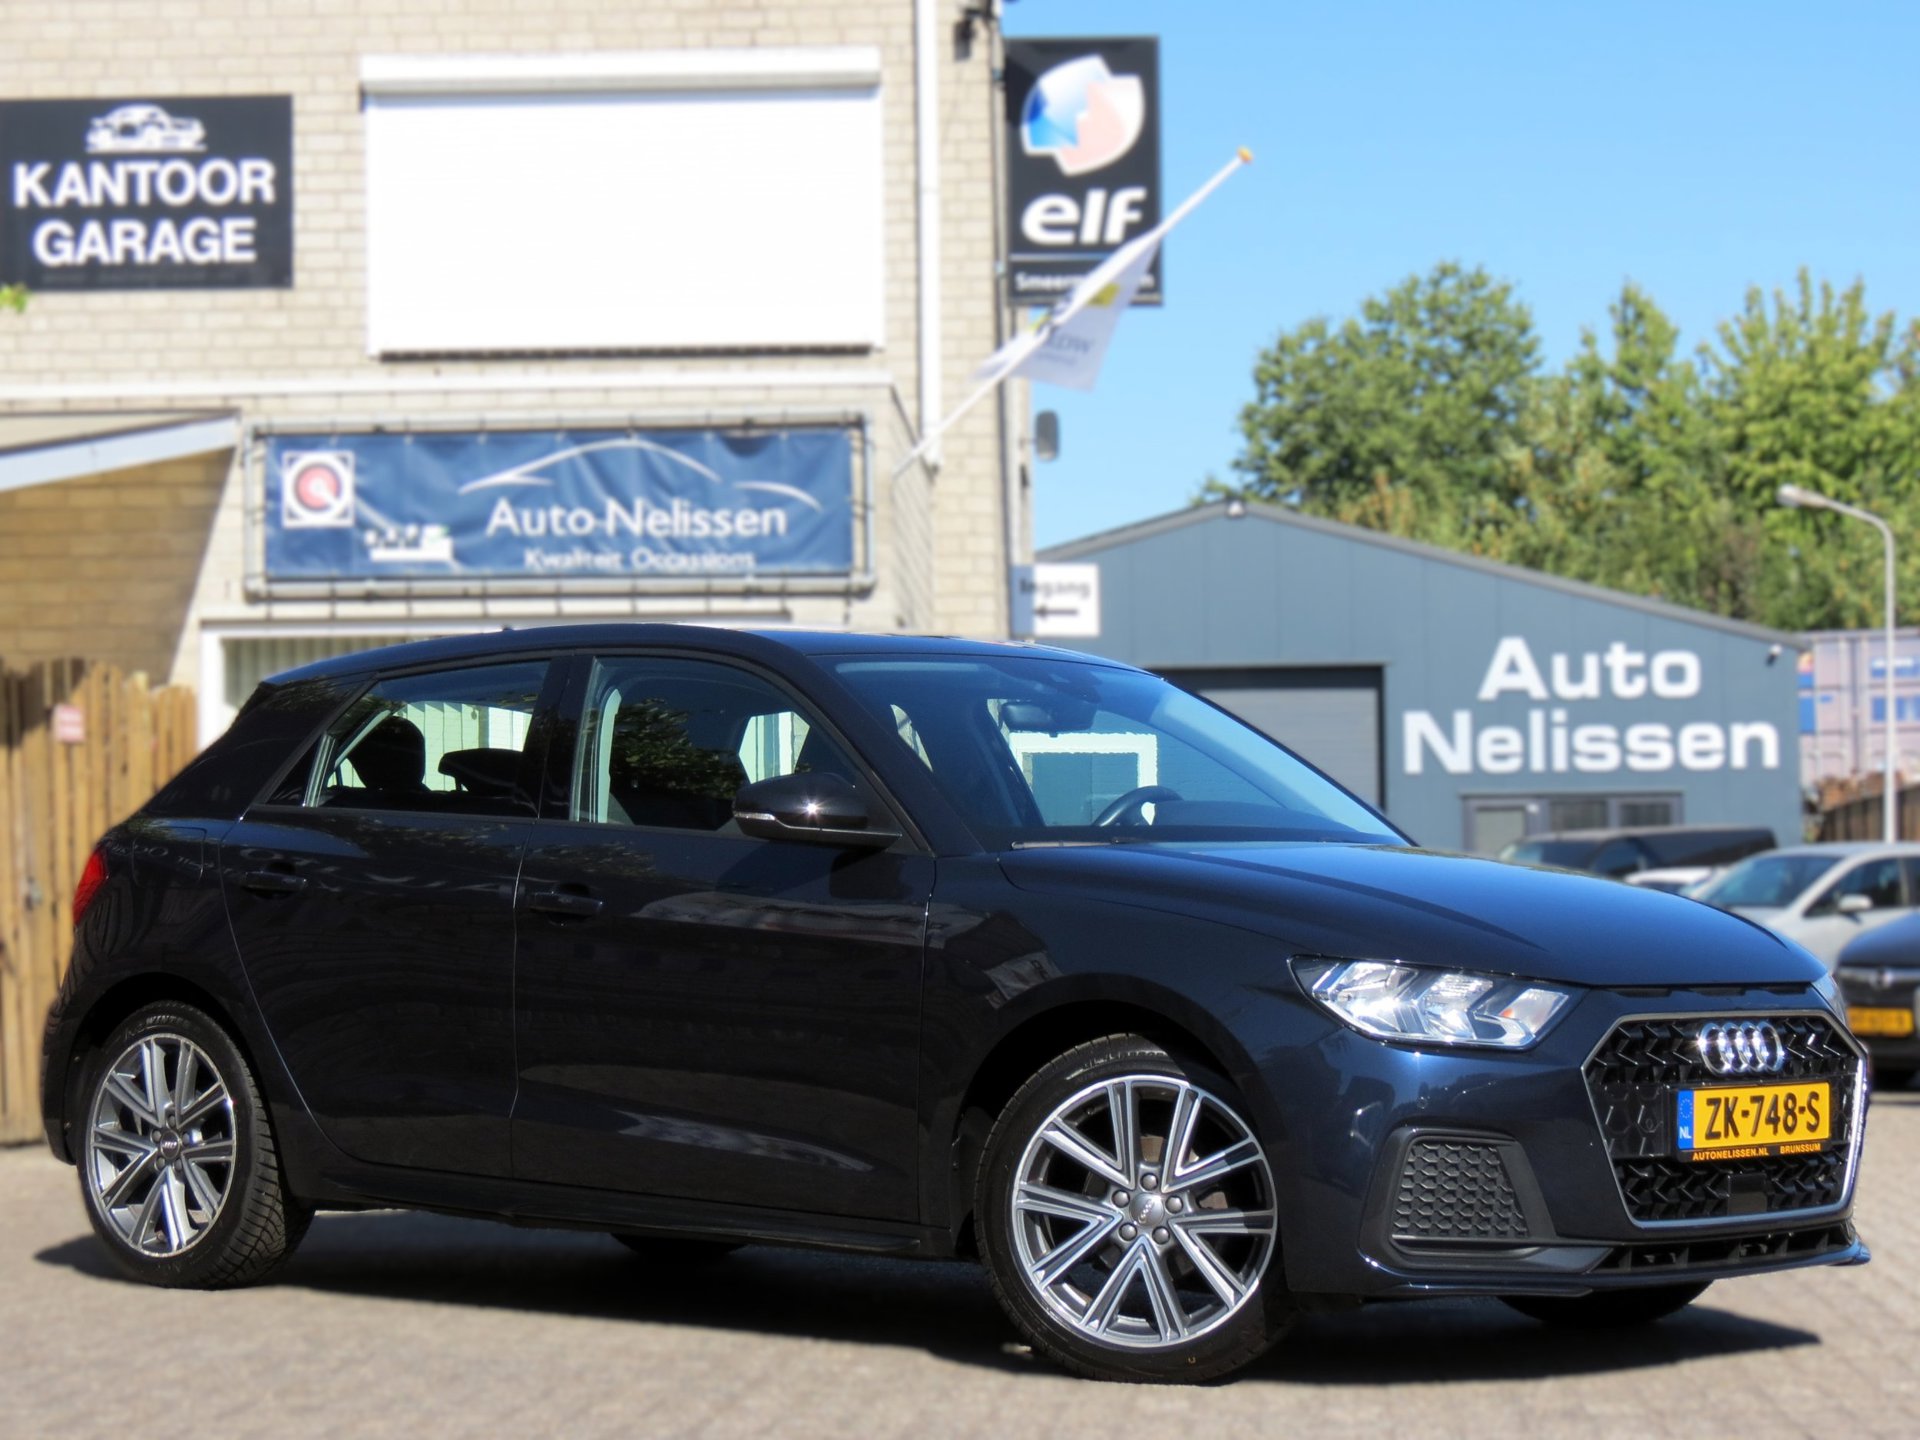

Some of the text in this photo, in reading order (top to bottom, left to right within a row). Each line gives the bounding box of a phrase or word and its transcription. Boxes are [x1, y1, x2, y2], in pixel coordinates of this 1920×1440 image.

[13, 158, 276, 207] KANTOOR
[1021, 187, 1147, 245] elf
[33, 217, 257, 266] GARAGE
[1478, 636, 1701, 700] Auto
[1403, 709, 1780, 774] Nelissen
[1679, 1126, 1692, 1139] NL
[1705, 1091, 1820, 1140] ZK-748-S
[1692, 1143, 1821, 1161] AUTONELISSEN.NL BRUNSSUM
